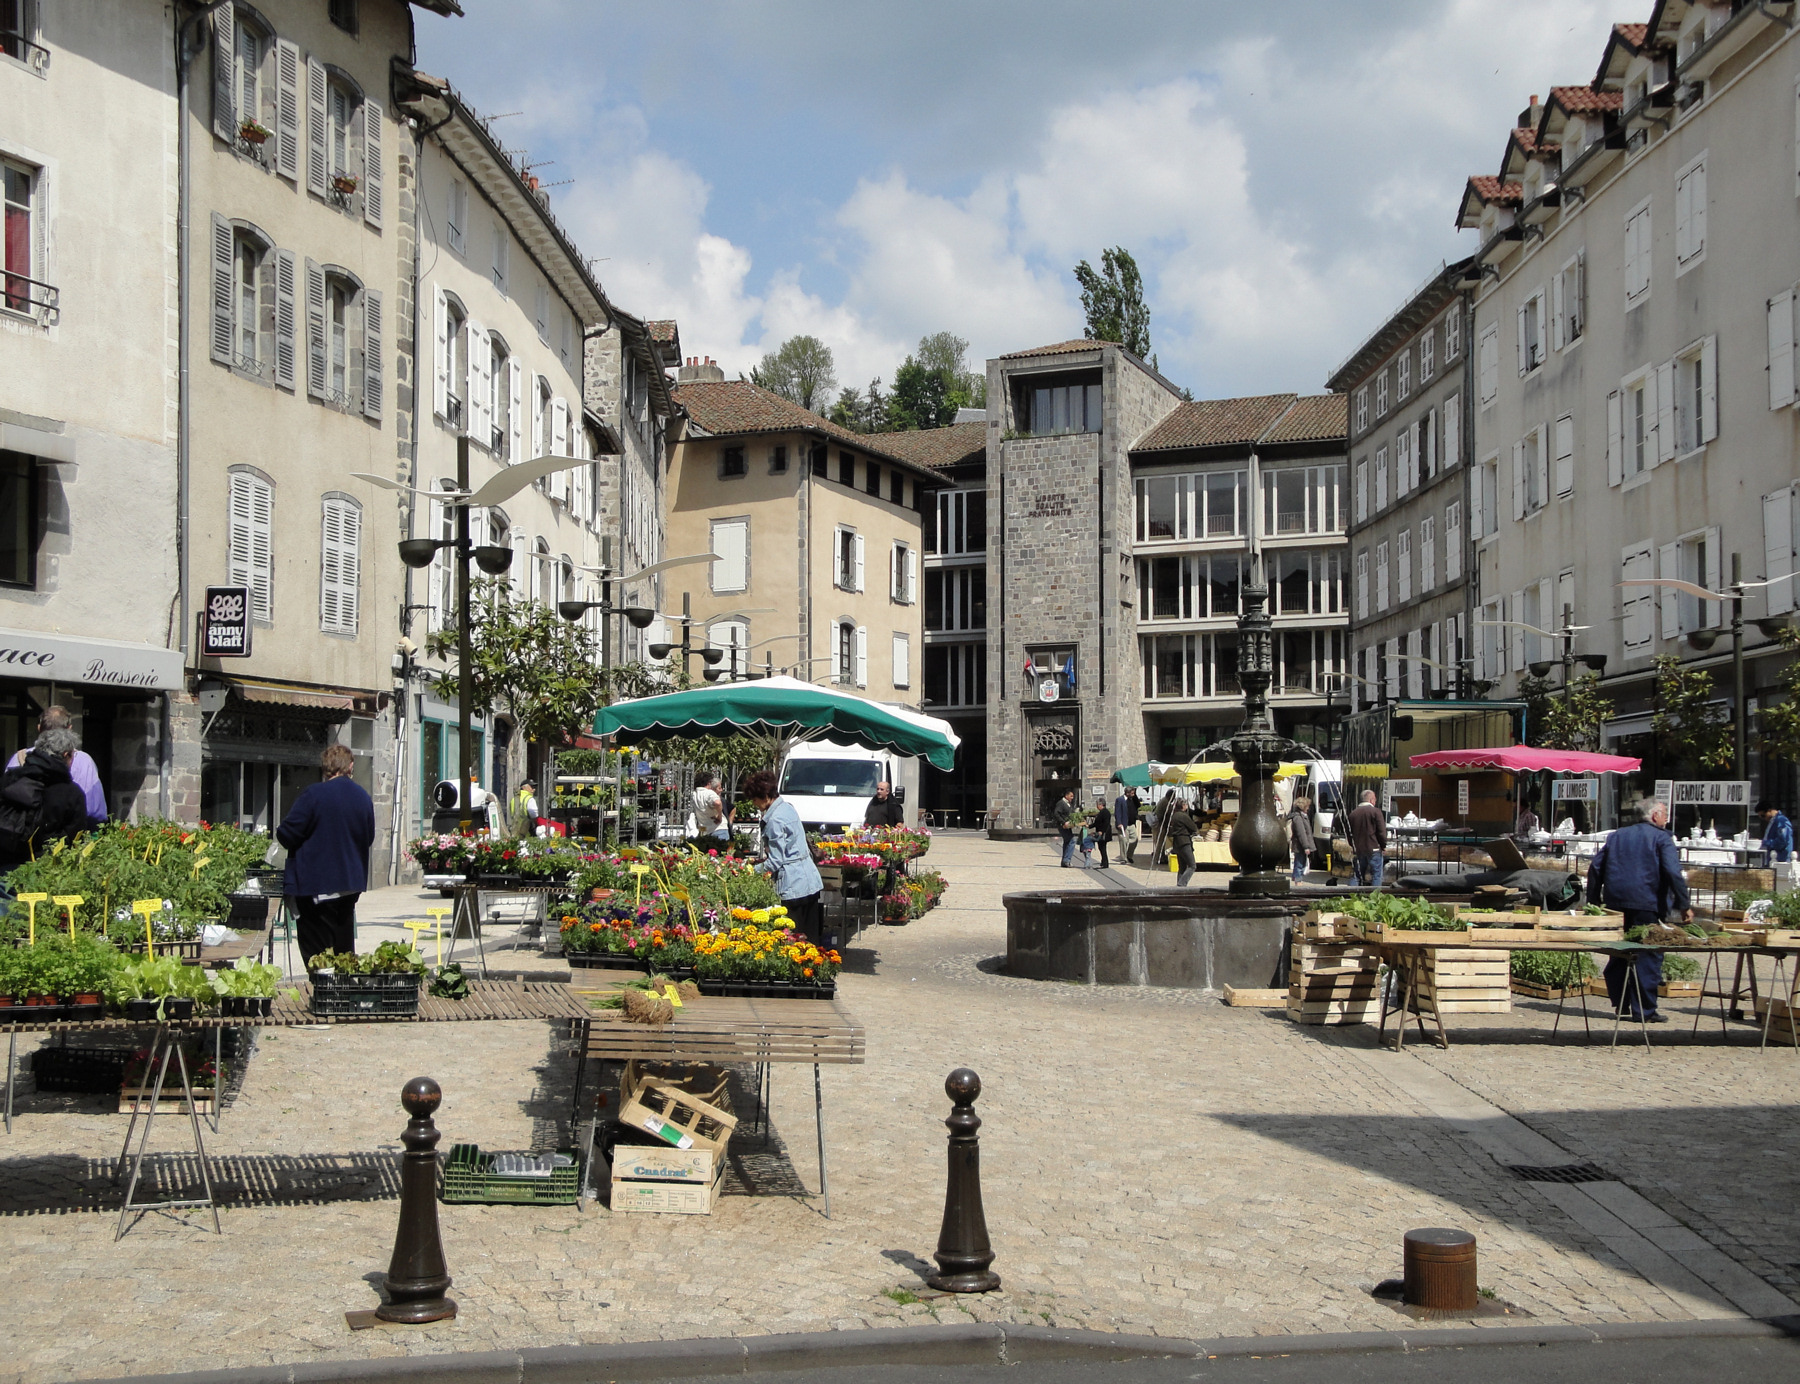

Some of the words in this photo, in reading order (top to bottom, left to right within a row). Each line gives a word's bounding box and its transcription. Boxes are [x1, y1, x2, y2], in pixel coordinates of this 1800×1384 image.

[208, 626, 243, 638] anny
[209, 636, 242, 647] blatt
[83, 658, 159, 686] Brasserie
[1557, 783, 1565, 798] DE
[1566, 782, 1588, 798] LIMOGES
[1675, 784, 1704, 801] VENDUE
[1710, 784, 1720, 801] AU
